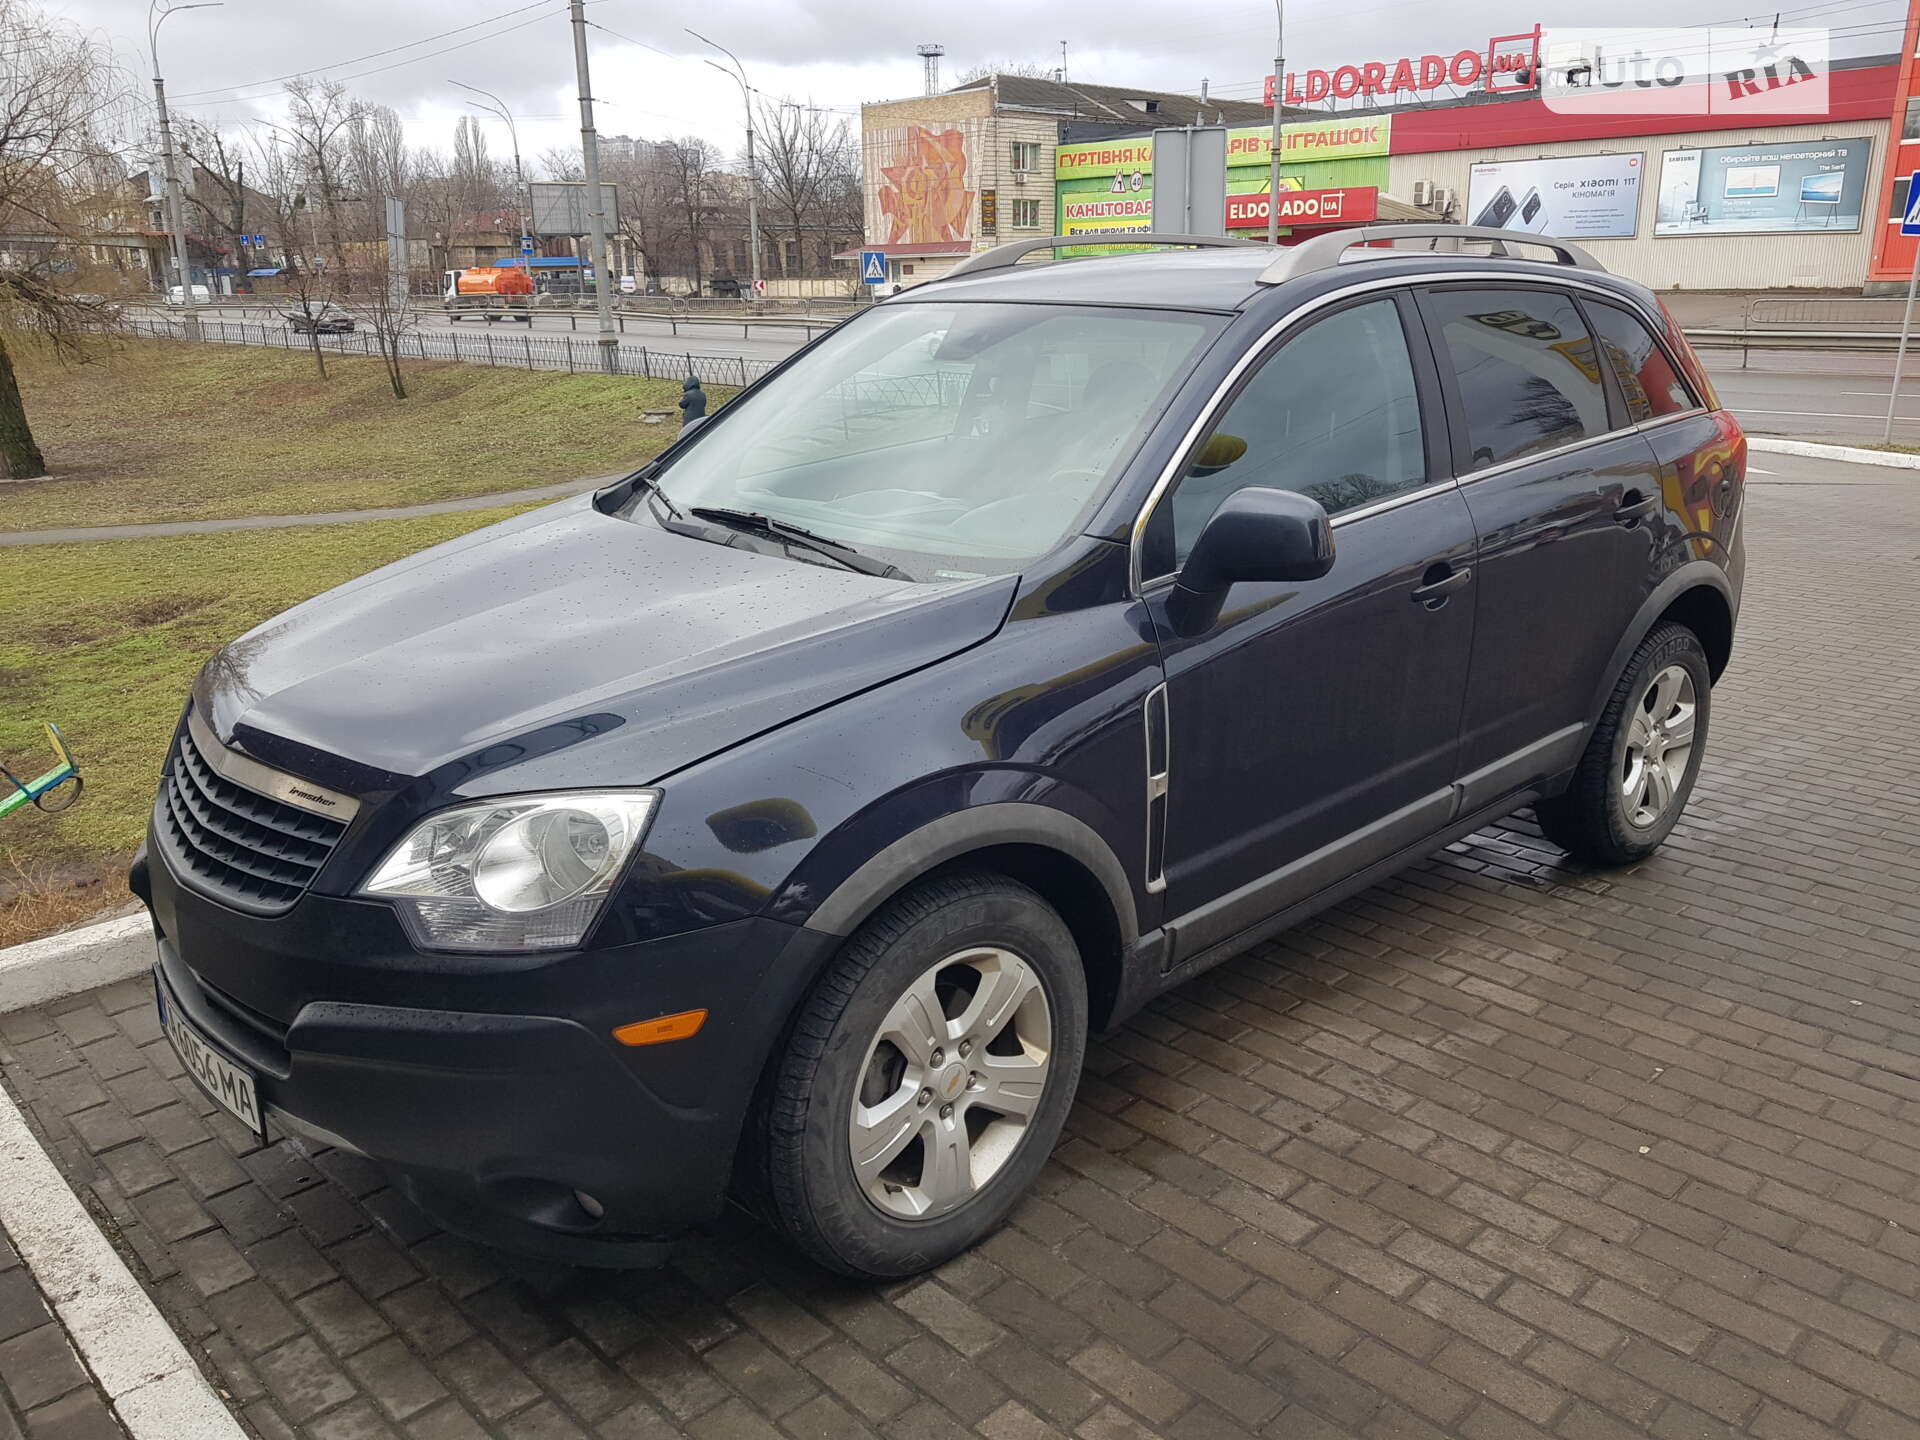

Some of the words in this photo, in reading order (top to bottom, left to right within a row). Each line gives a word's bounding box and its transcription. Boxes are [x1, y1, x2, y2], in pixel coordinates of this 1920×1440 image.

[1263, 50, 1482, 107] ELDORADO
[1496, 52, 1527, 74] UA
[1059, 148, 1133, 168] ГУРТІВНЯ
[1287, 126, 1379, 149] ІГРАШОК
[1838, 149, 1848, 158] ТВ
[1132, 177, 1141, 186] 40
[1553, 182, 1575, 190] Серія
[1572, 190, 1616, 199] КІНОМАГІЯ
[1230, 199, 1318, 219] ELDOADO
[1324, 202, 1338, 211] UA
[289, 786, 336, 807] irmscher
